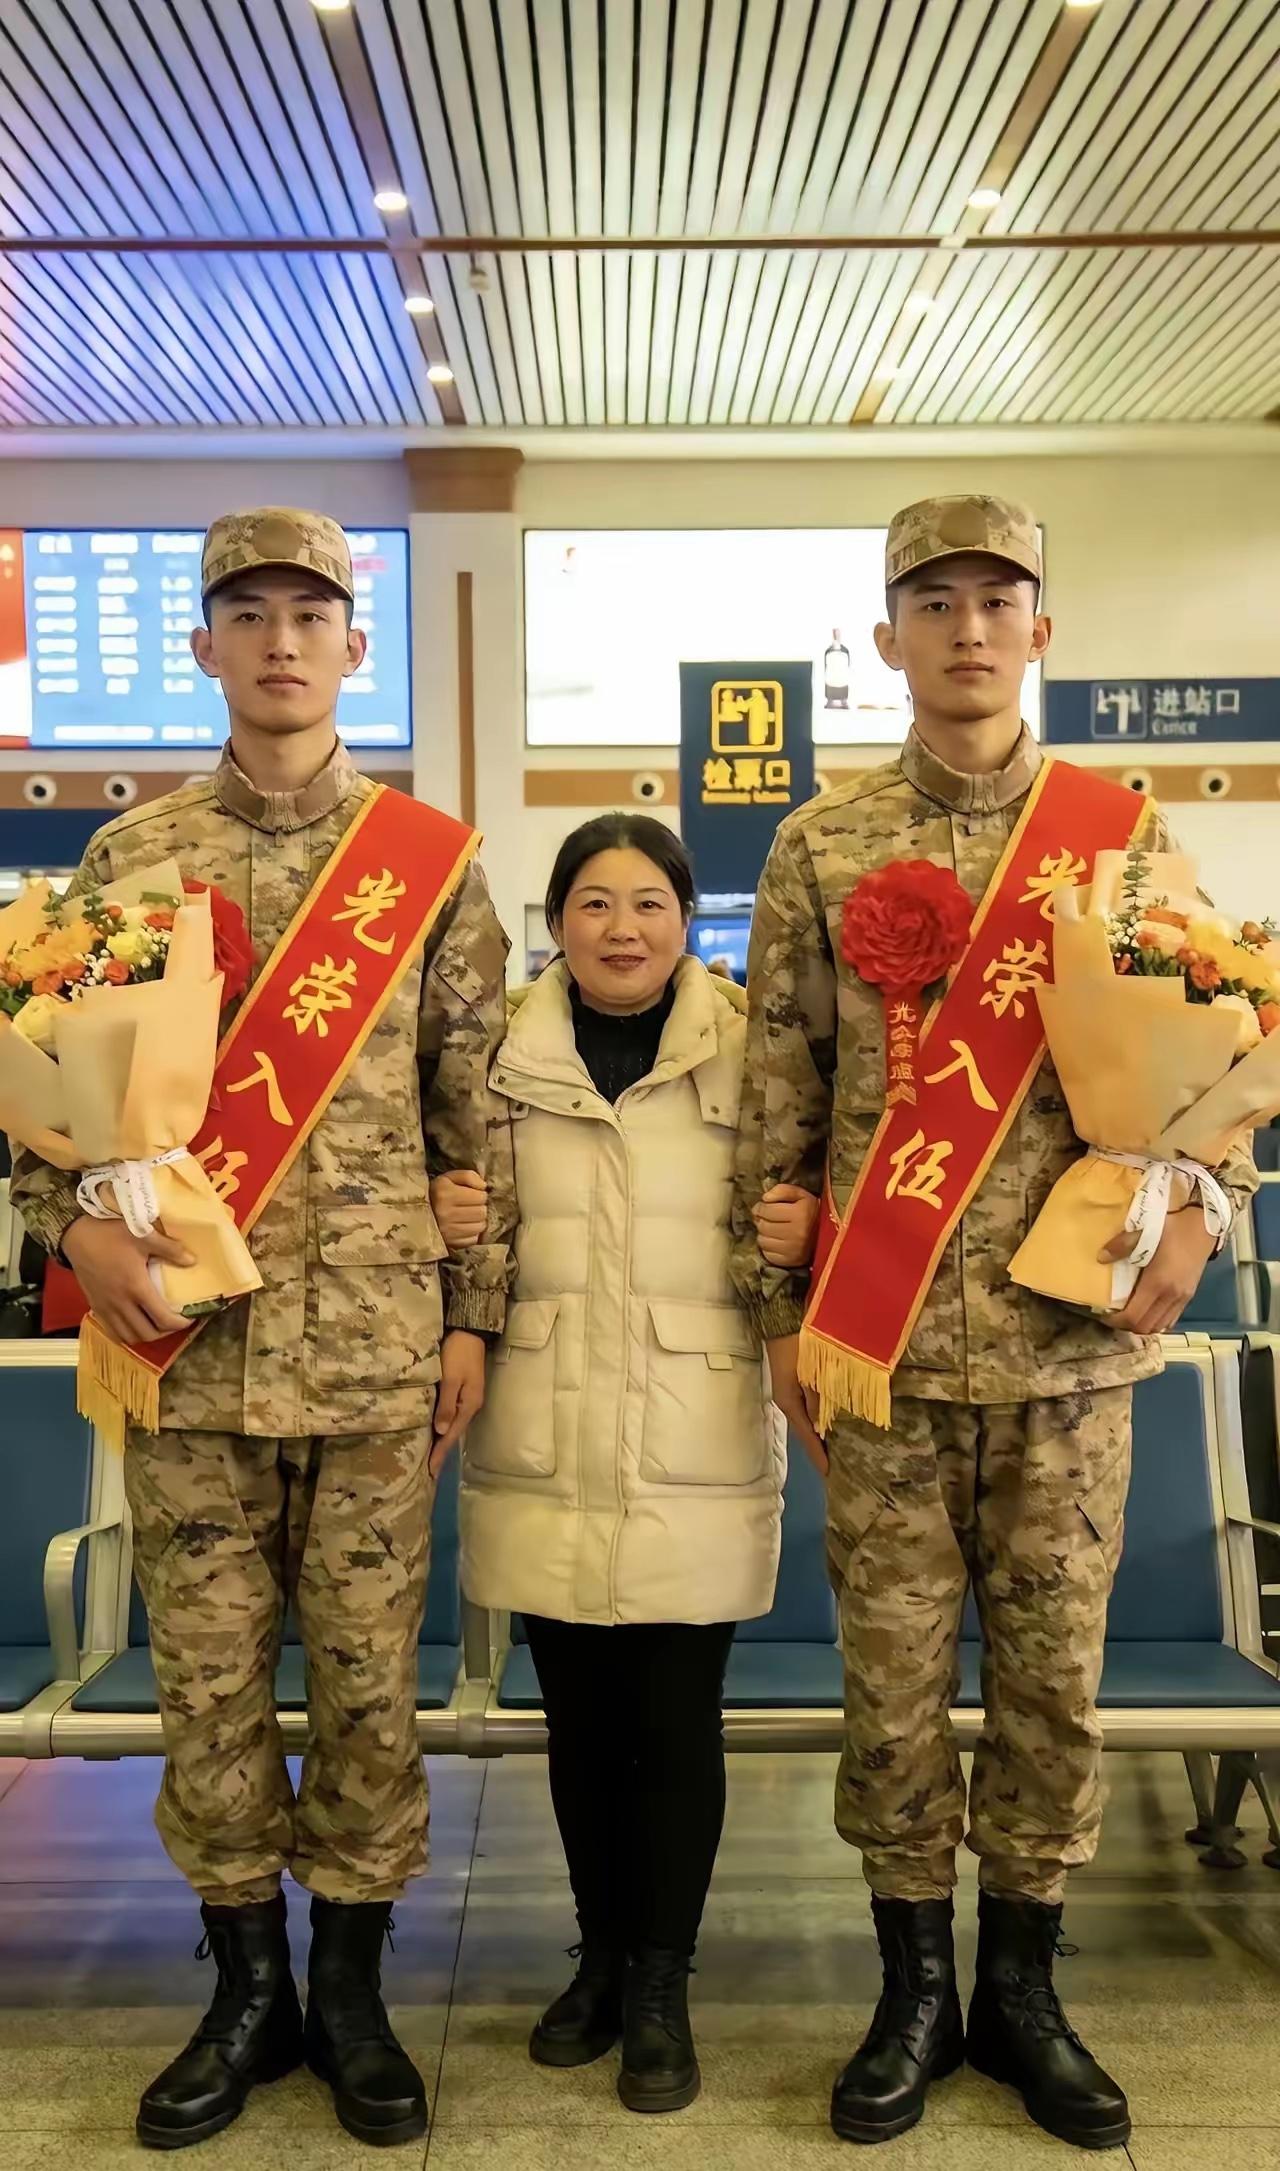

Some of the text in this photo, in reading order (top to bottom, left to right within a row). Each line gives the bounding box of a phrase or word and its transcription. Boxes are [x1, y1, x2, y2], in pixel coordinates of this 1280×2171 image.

[1152, 686, 1240, 717] 进站口
[885, 847, 1089, 1209] 光荣入伍
